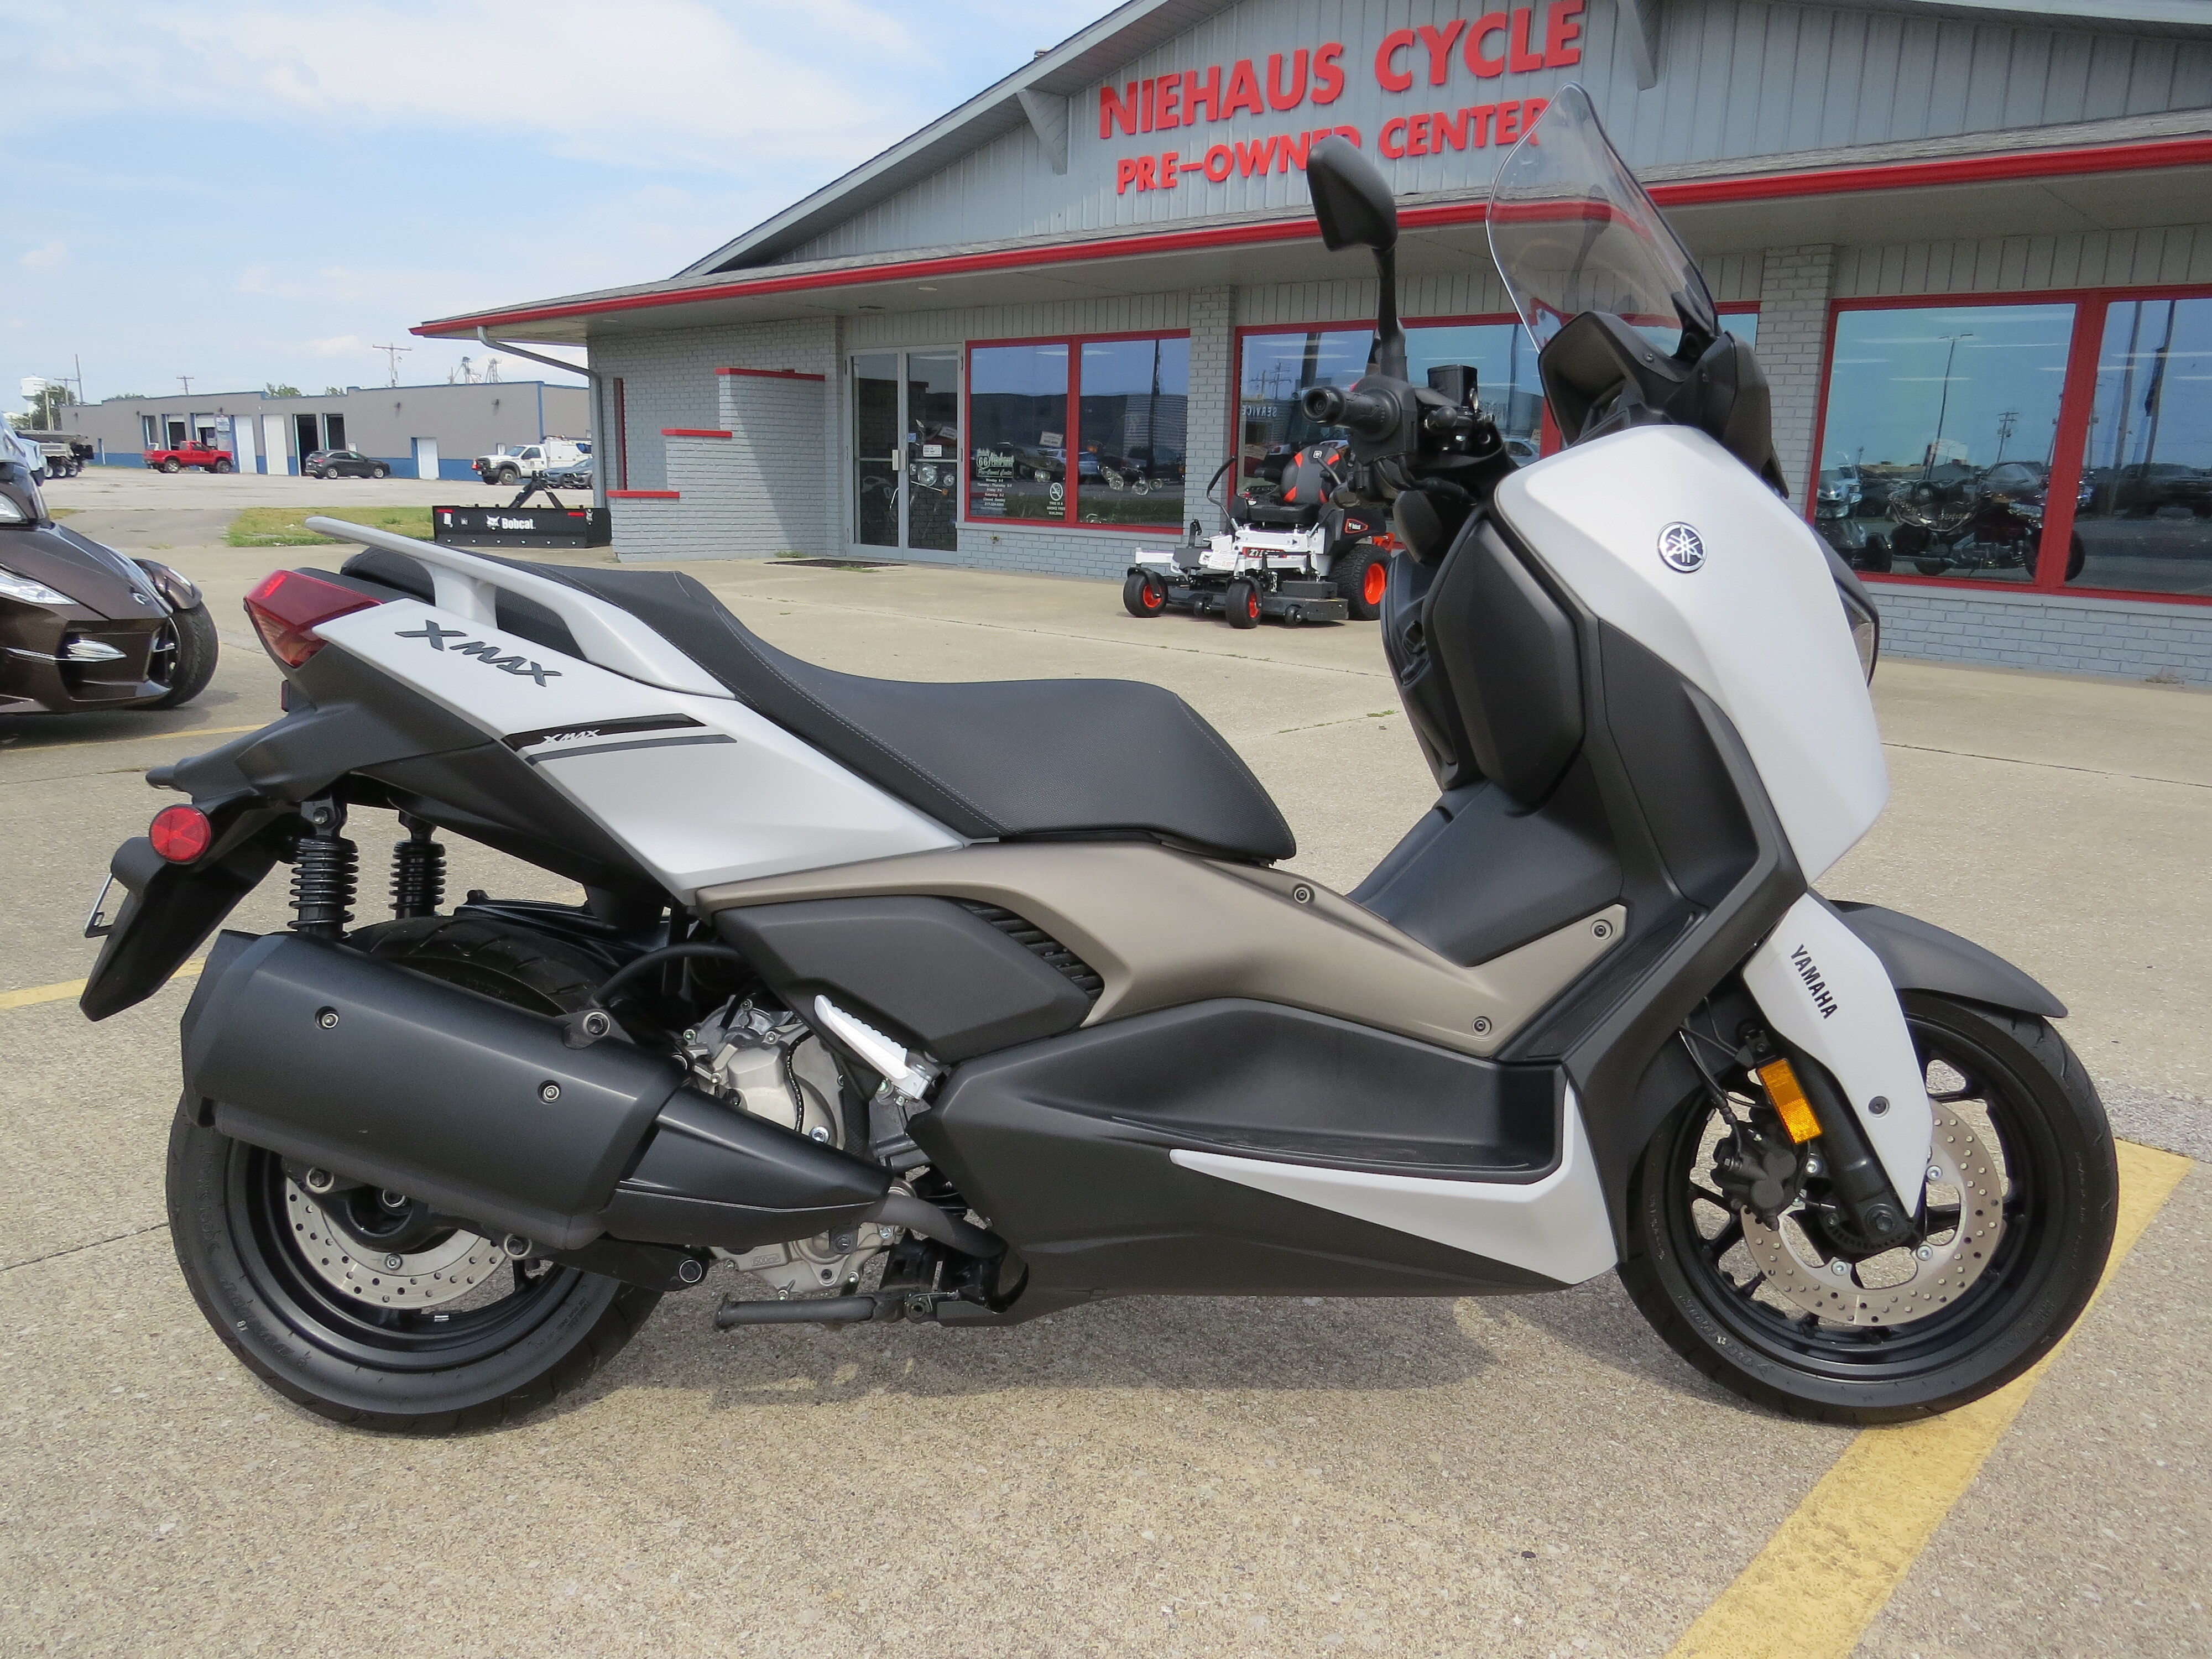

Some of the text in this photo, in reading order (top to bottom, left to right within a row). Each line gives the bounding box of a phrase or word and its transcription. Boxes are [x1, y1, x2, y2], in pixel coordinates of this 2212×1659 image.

[1099, 1, 1584, 140] NIEHAUS CYCLE
[1117, 97, 1550, 195] PRE-OWN CENTER
[978, 457, 988, 467] 66
[501, 517, 535, 530] Bobcat
[1790, 943, 1838, 1020] YAMAHA
